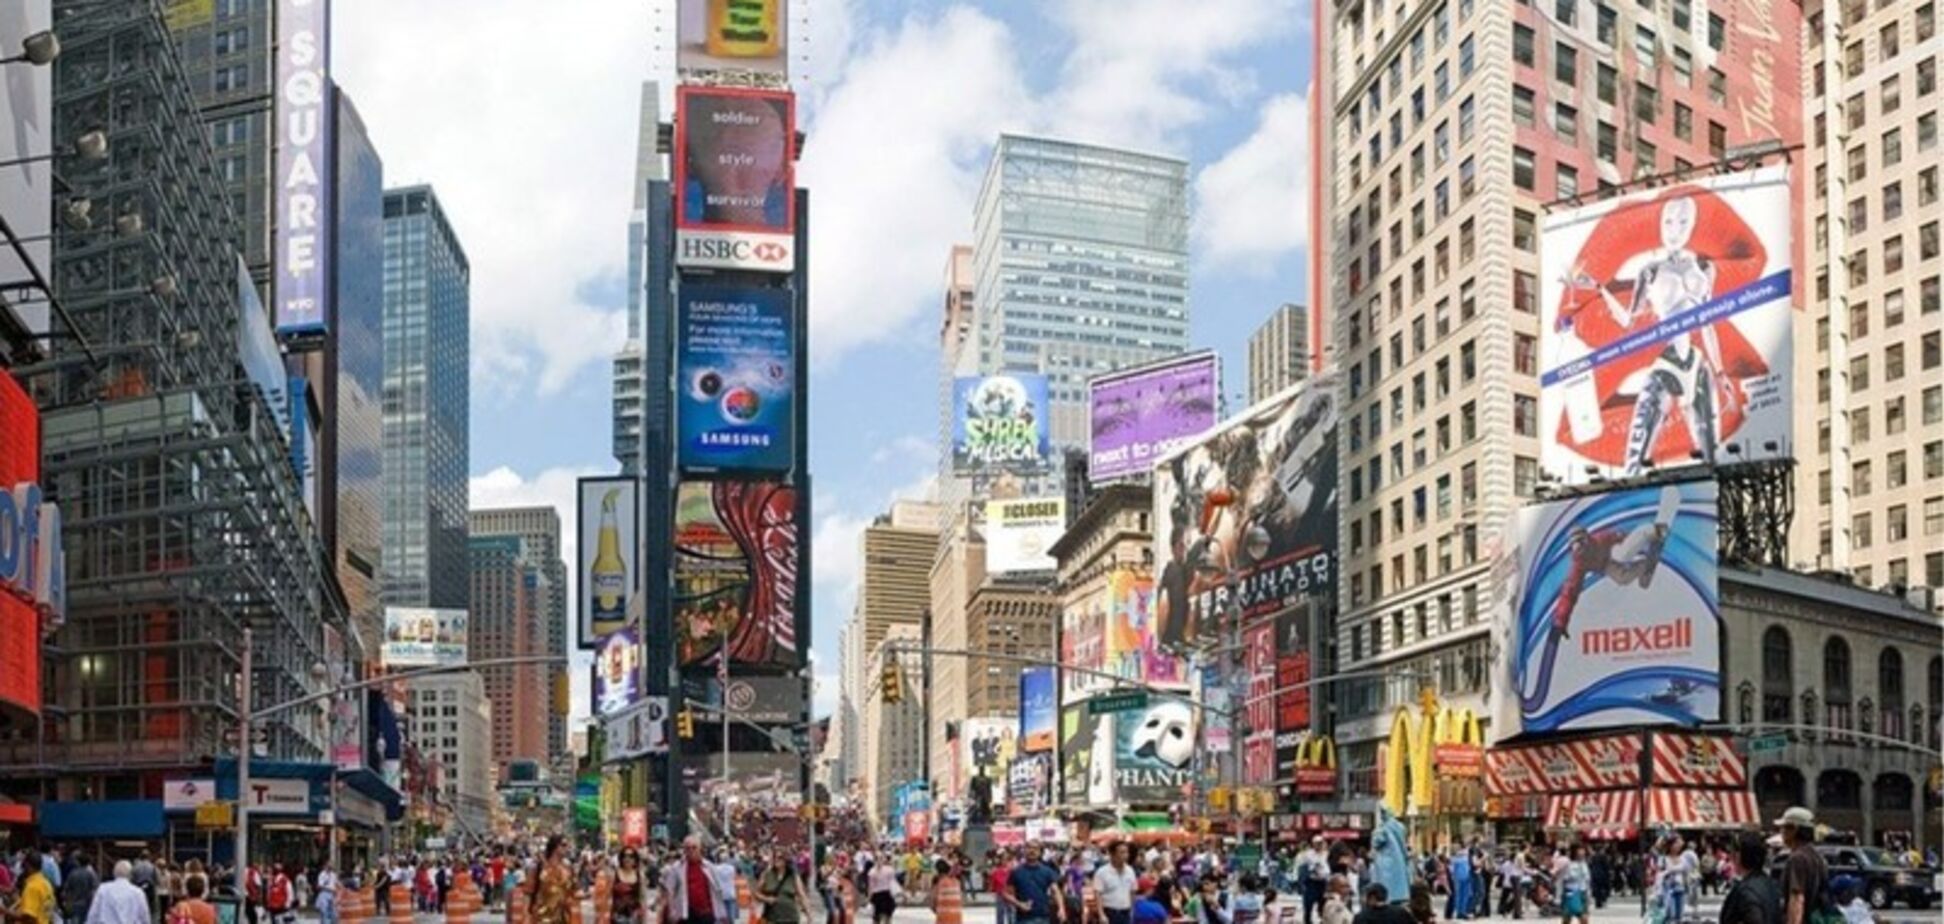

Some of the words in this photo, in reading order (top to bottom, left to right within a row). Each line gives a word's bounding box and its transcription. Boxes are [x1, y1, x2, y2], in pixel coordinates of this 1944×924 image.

[1737, 49, 1782, 139] Juan
[713, 111, 760, 124] soldier
[285, 30, 322, 272] SQUARE
[719, 153, 754, 166] style
[707, 193, 765, 207] survivor
[683, 239, 750, 260] HSBC
[689, 300, 758, 314] SAMSUNG'S
[1659, 321, 1680, 338] live
[1682, 315, 1697, 327] on
[1699, 299, 1736, 321] gossip
[701, 432, 770, 446] SAMSUNG
[966, 417, 1038, 447] SHREK
[967, 441, 1042, 464] MUSICAL
[1094, 444, 1128, 465] next
[1132, 442, 1150, 458] to
[1012, 502, 1058, 518] CLOSER
[1188, 549, 1338, 614] TERMINATO
[1201, 570, 1329, 620] SAVATION
[1582, 617, 1691, 654] maxell
